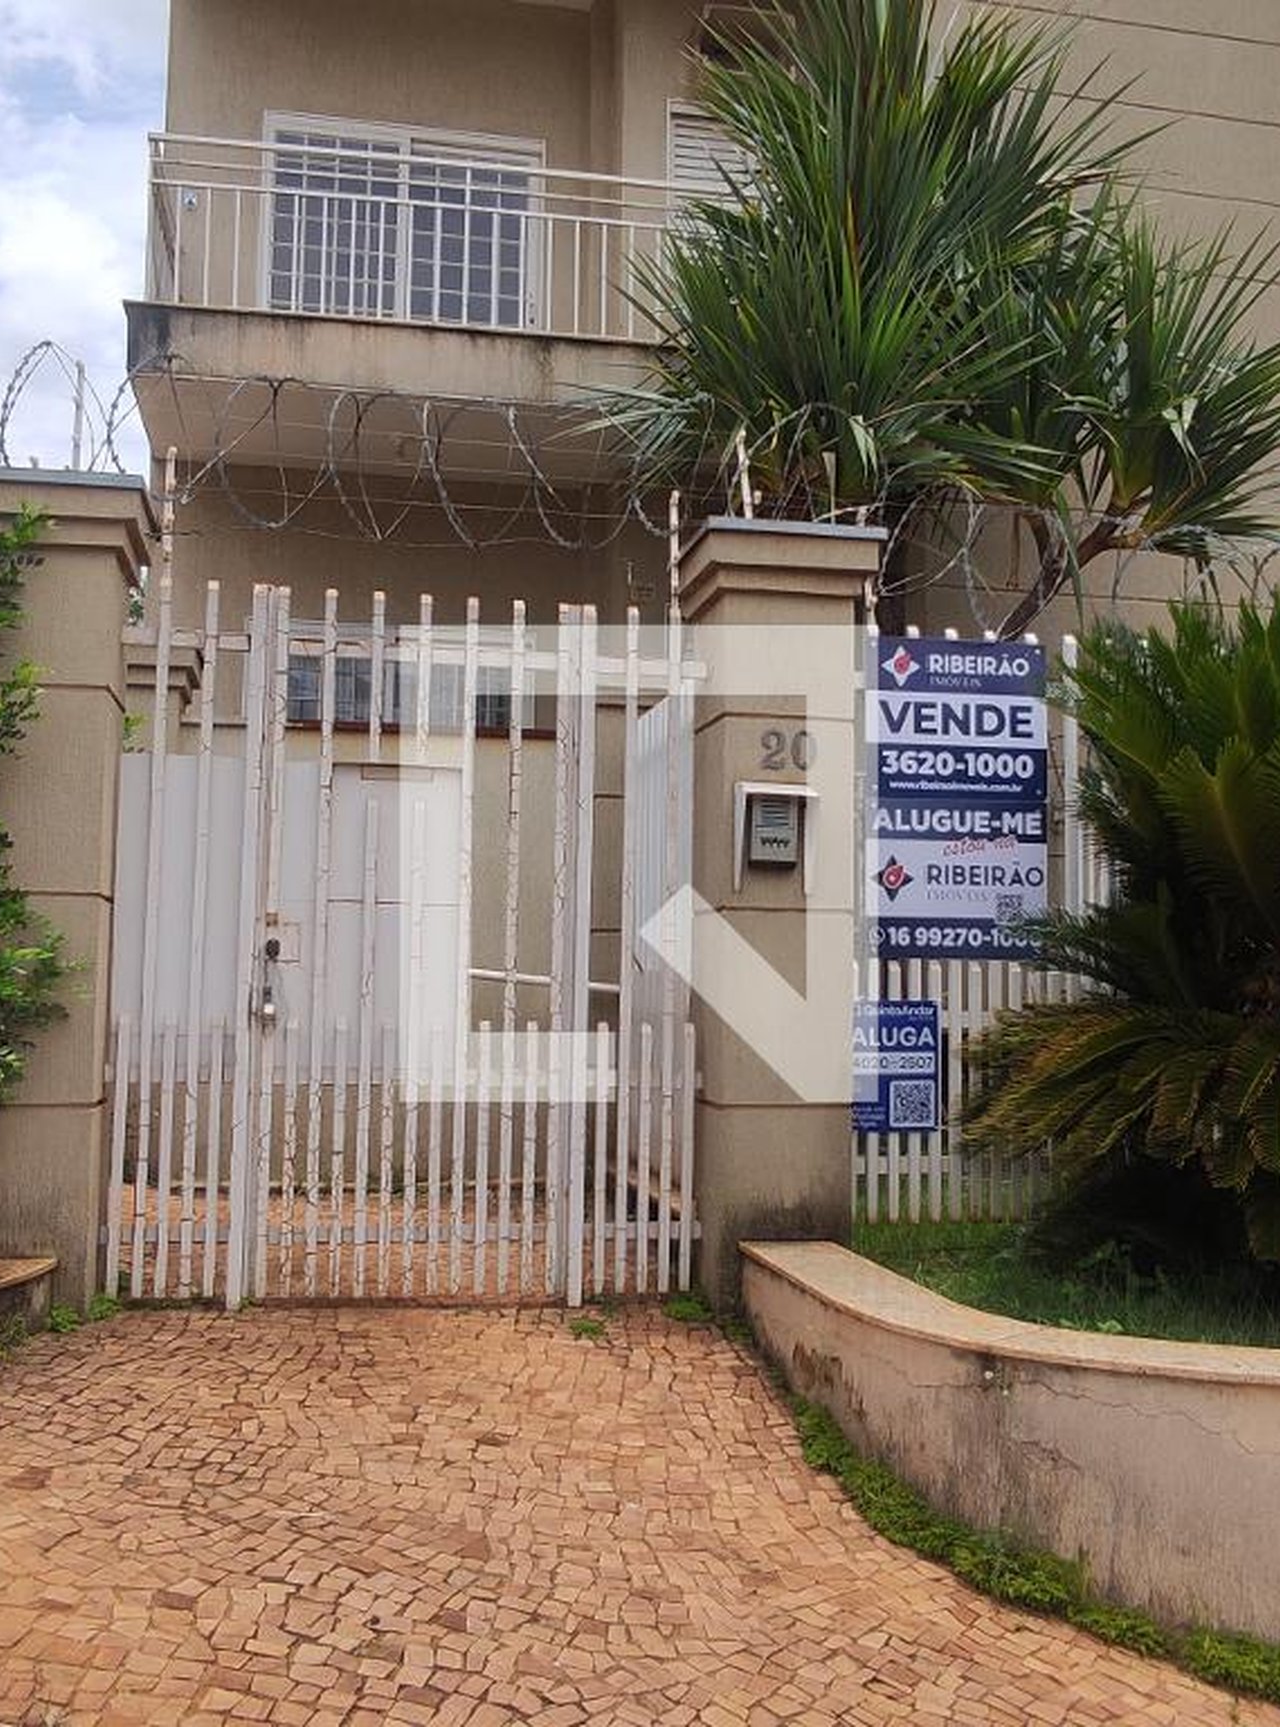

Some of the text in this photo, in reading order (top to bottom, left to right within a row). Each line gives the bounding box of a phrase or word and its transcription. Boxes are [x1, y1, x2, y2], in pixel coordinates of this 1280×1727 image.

[929, 653, 1030, 677] RIBEIRÃO
[879, 700, 1034, 738] VENDE
[761, 731, 818, 770] 20
[881, 751, 1034, 778] 3620-1000
[872, 808, 1042, 835] ALUGUE-ME
[927, 861, 1044, 886] RIBEIRÃO
[889, 927, 910, 947] 16
[853, 1026, 934, 1046] ALUGA
